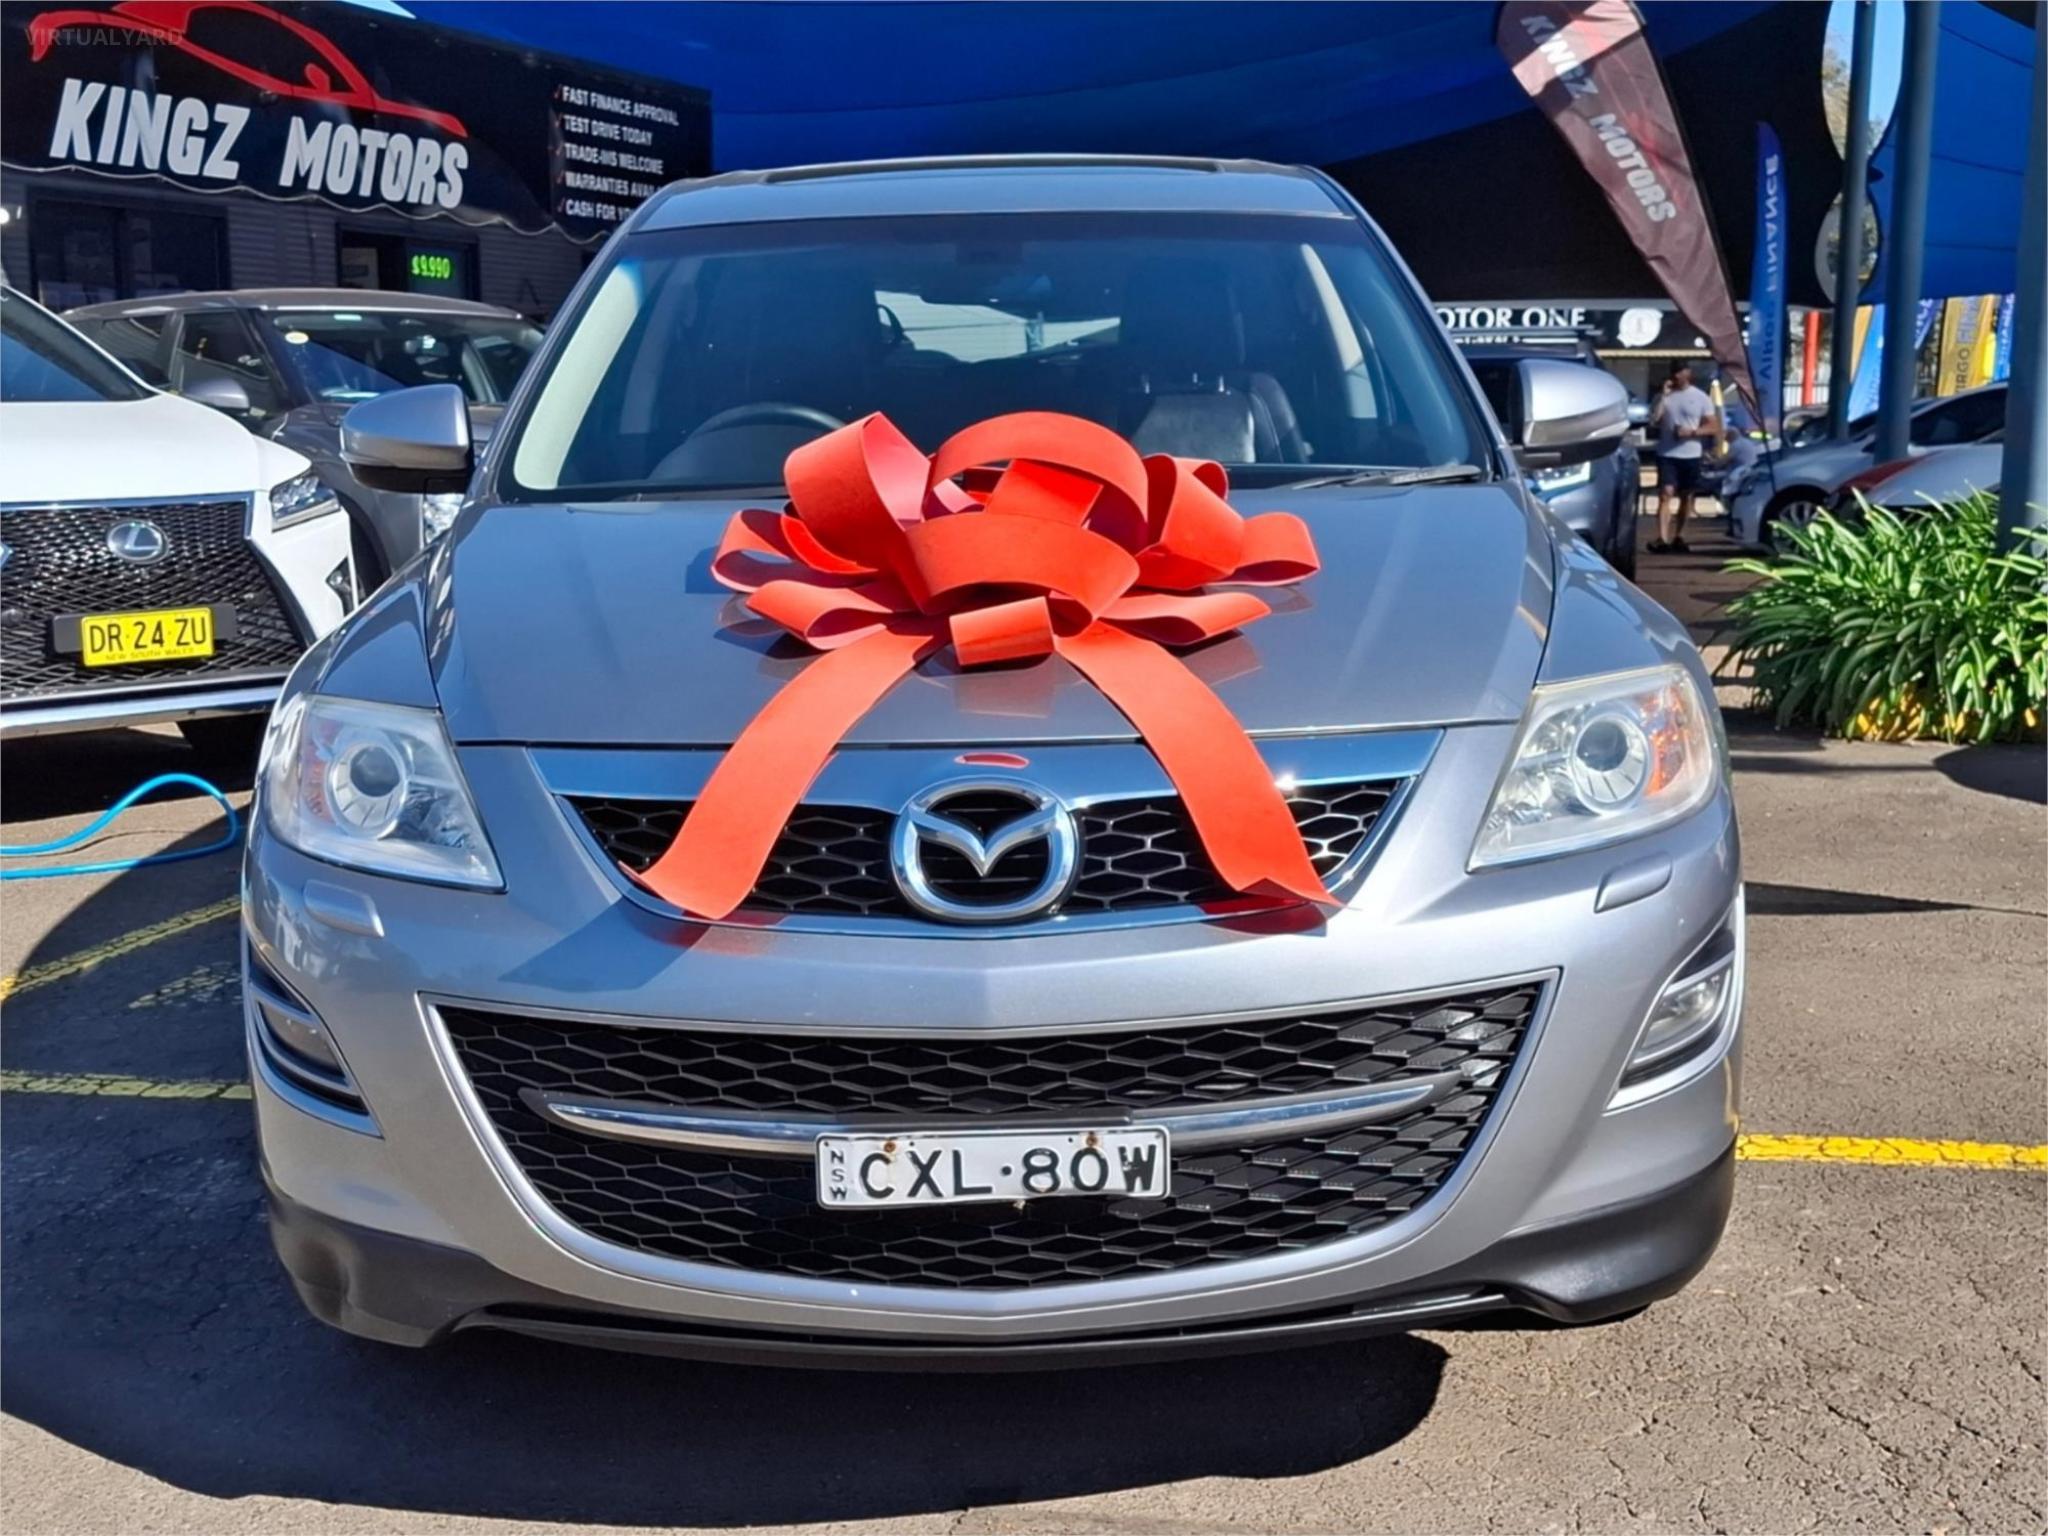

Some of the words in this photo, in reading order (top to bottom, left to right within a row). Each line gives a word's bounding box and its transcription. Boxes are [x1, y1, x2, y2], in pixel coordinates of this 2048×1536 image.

[562, 86, 588, 106] FAST
[590, 92, 632, 116] FINANCE
[633, 102, 679, 126] APPROVAL
[1520, 15, 1598, 98] KINGZ
[1589, 113, 1676, 222] MOTORS
[49, 78, 251, 180] KINGZ
[279, 116, 469, 209] MOTORS
[563, 114, 589, 134] TEST
[591, 120, 620, 140] DRIVE
[621, 126, 653, 146] TODAY
[564, 142, 617, 167] TRADE-INS
[618, 153, 664, 175] WELCOME
[565, 171, 629, 196] WARRANTIES
[566, 199, 594, 217] CASH
[596, 203, 616, 220] FOR
[1436, 307, 1513, 329] OTOR
[1521, 307, 1586, 328] ONE
